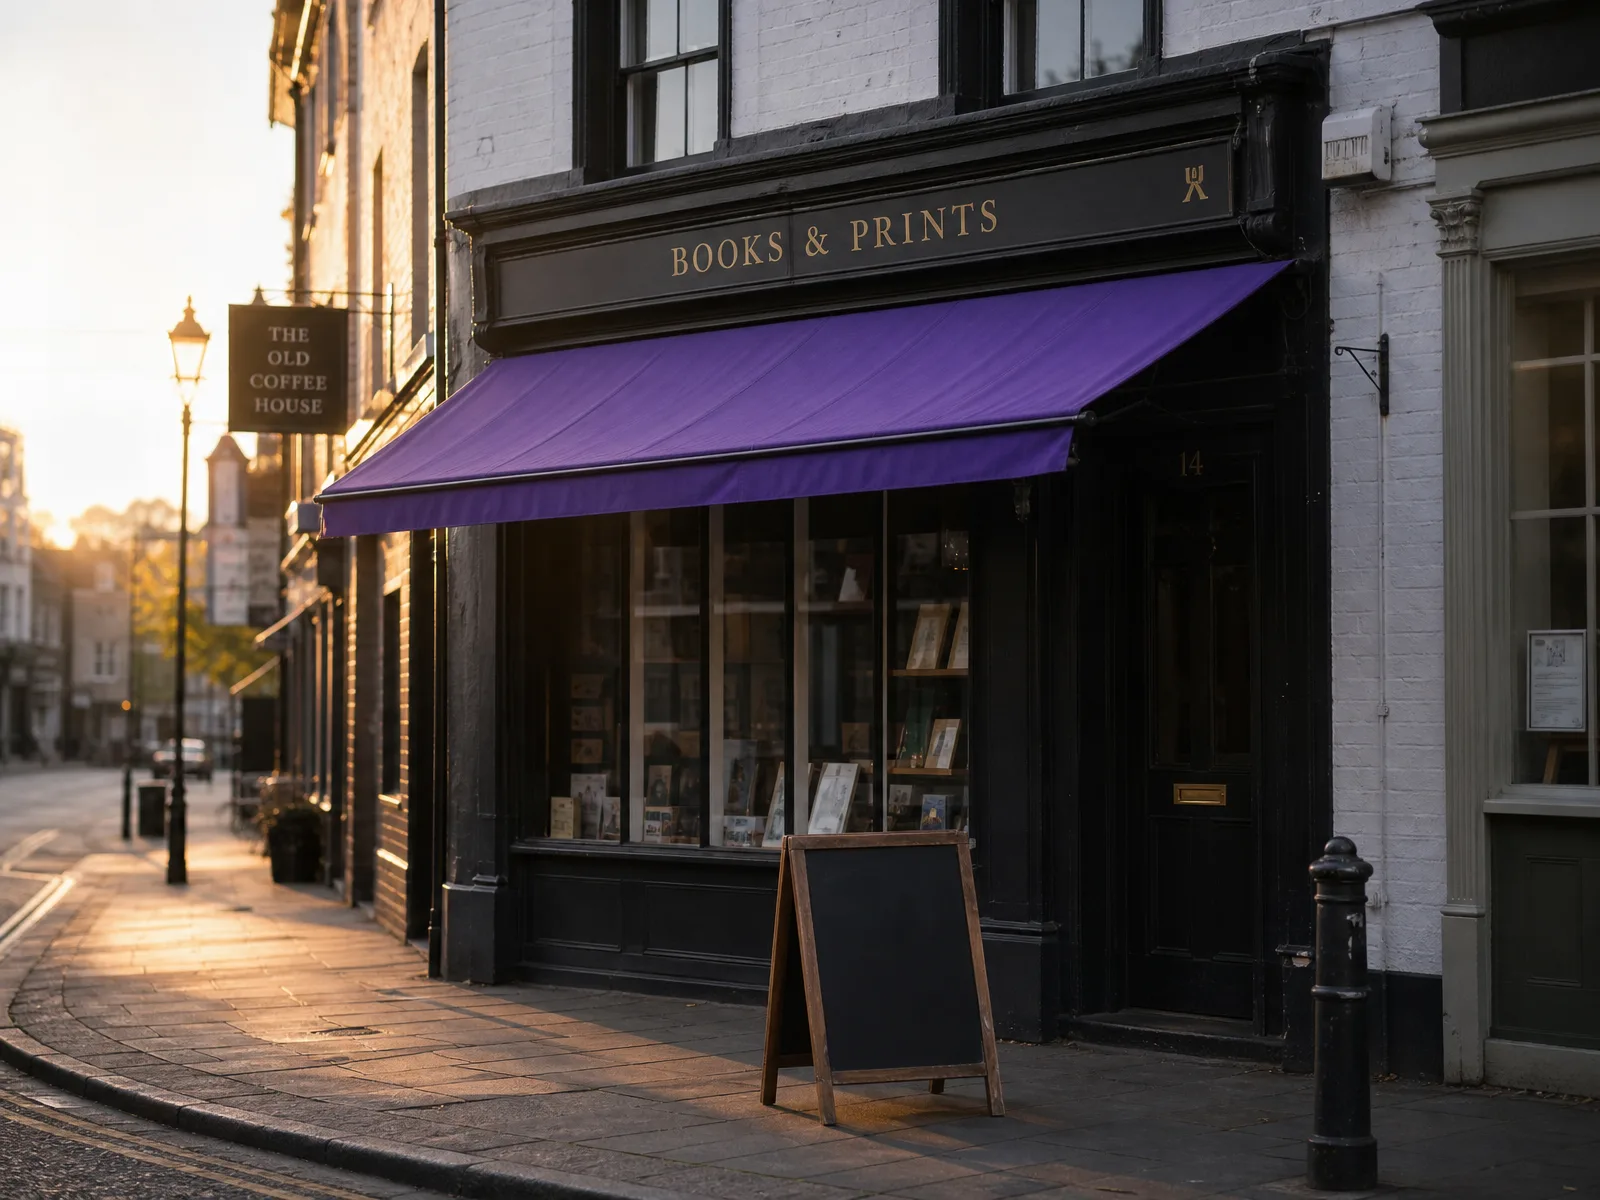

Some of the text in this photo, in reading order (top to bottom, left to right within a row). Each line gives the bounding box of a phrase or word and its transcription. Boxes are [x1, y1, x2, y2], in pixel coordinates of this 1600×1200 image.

[671, 199, 998, 277] BOOKS & PRINTS
[268, 326, 310, 343] THE
[268, 350, 310, 366] OLD
[250, 373, 328, 391] COFFEE
[255, 397, 323, 414] HOUSE
[1179, 449, 1204, 477] 14
